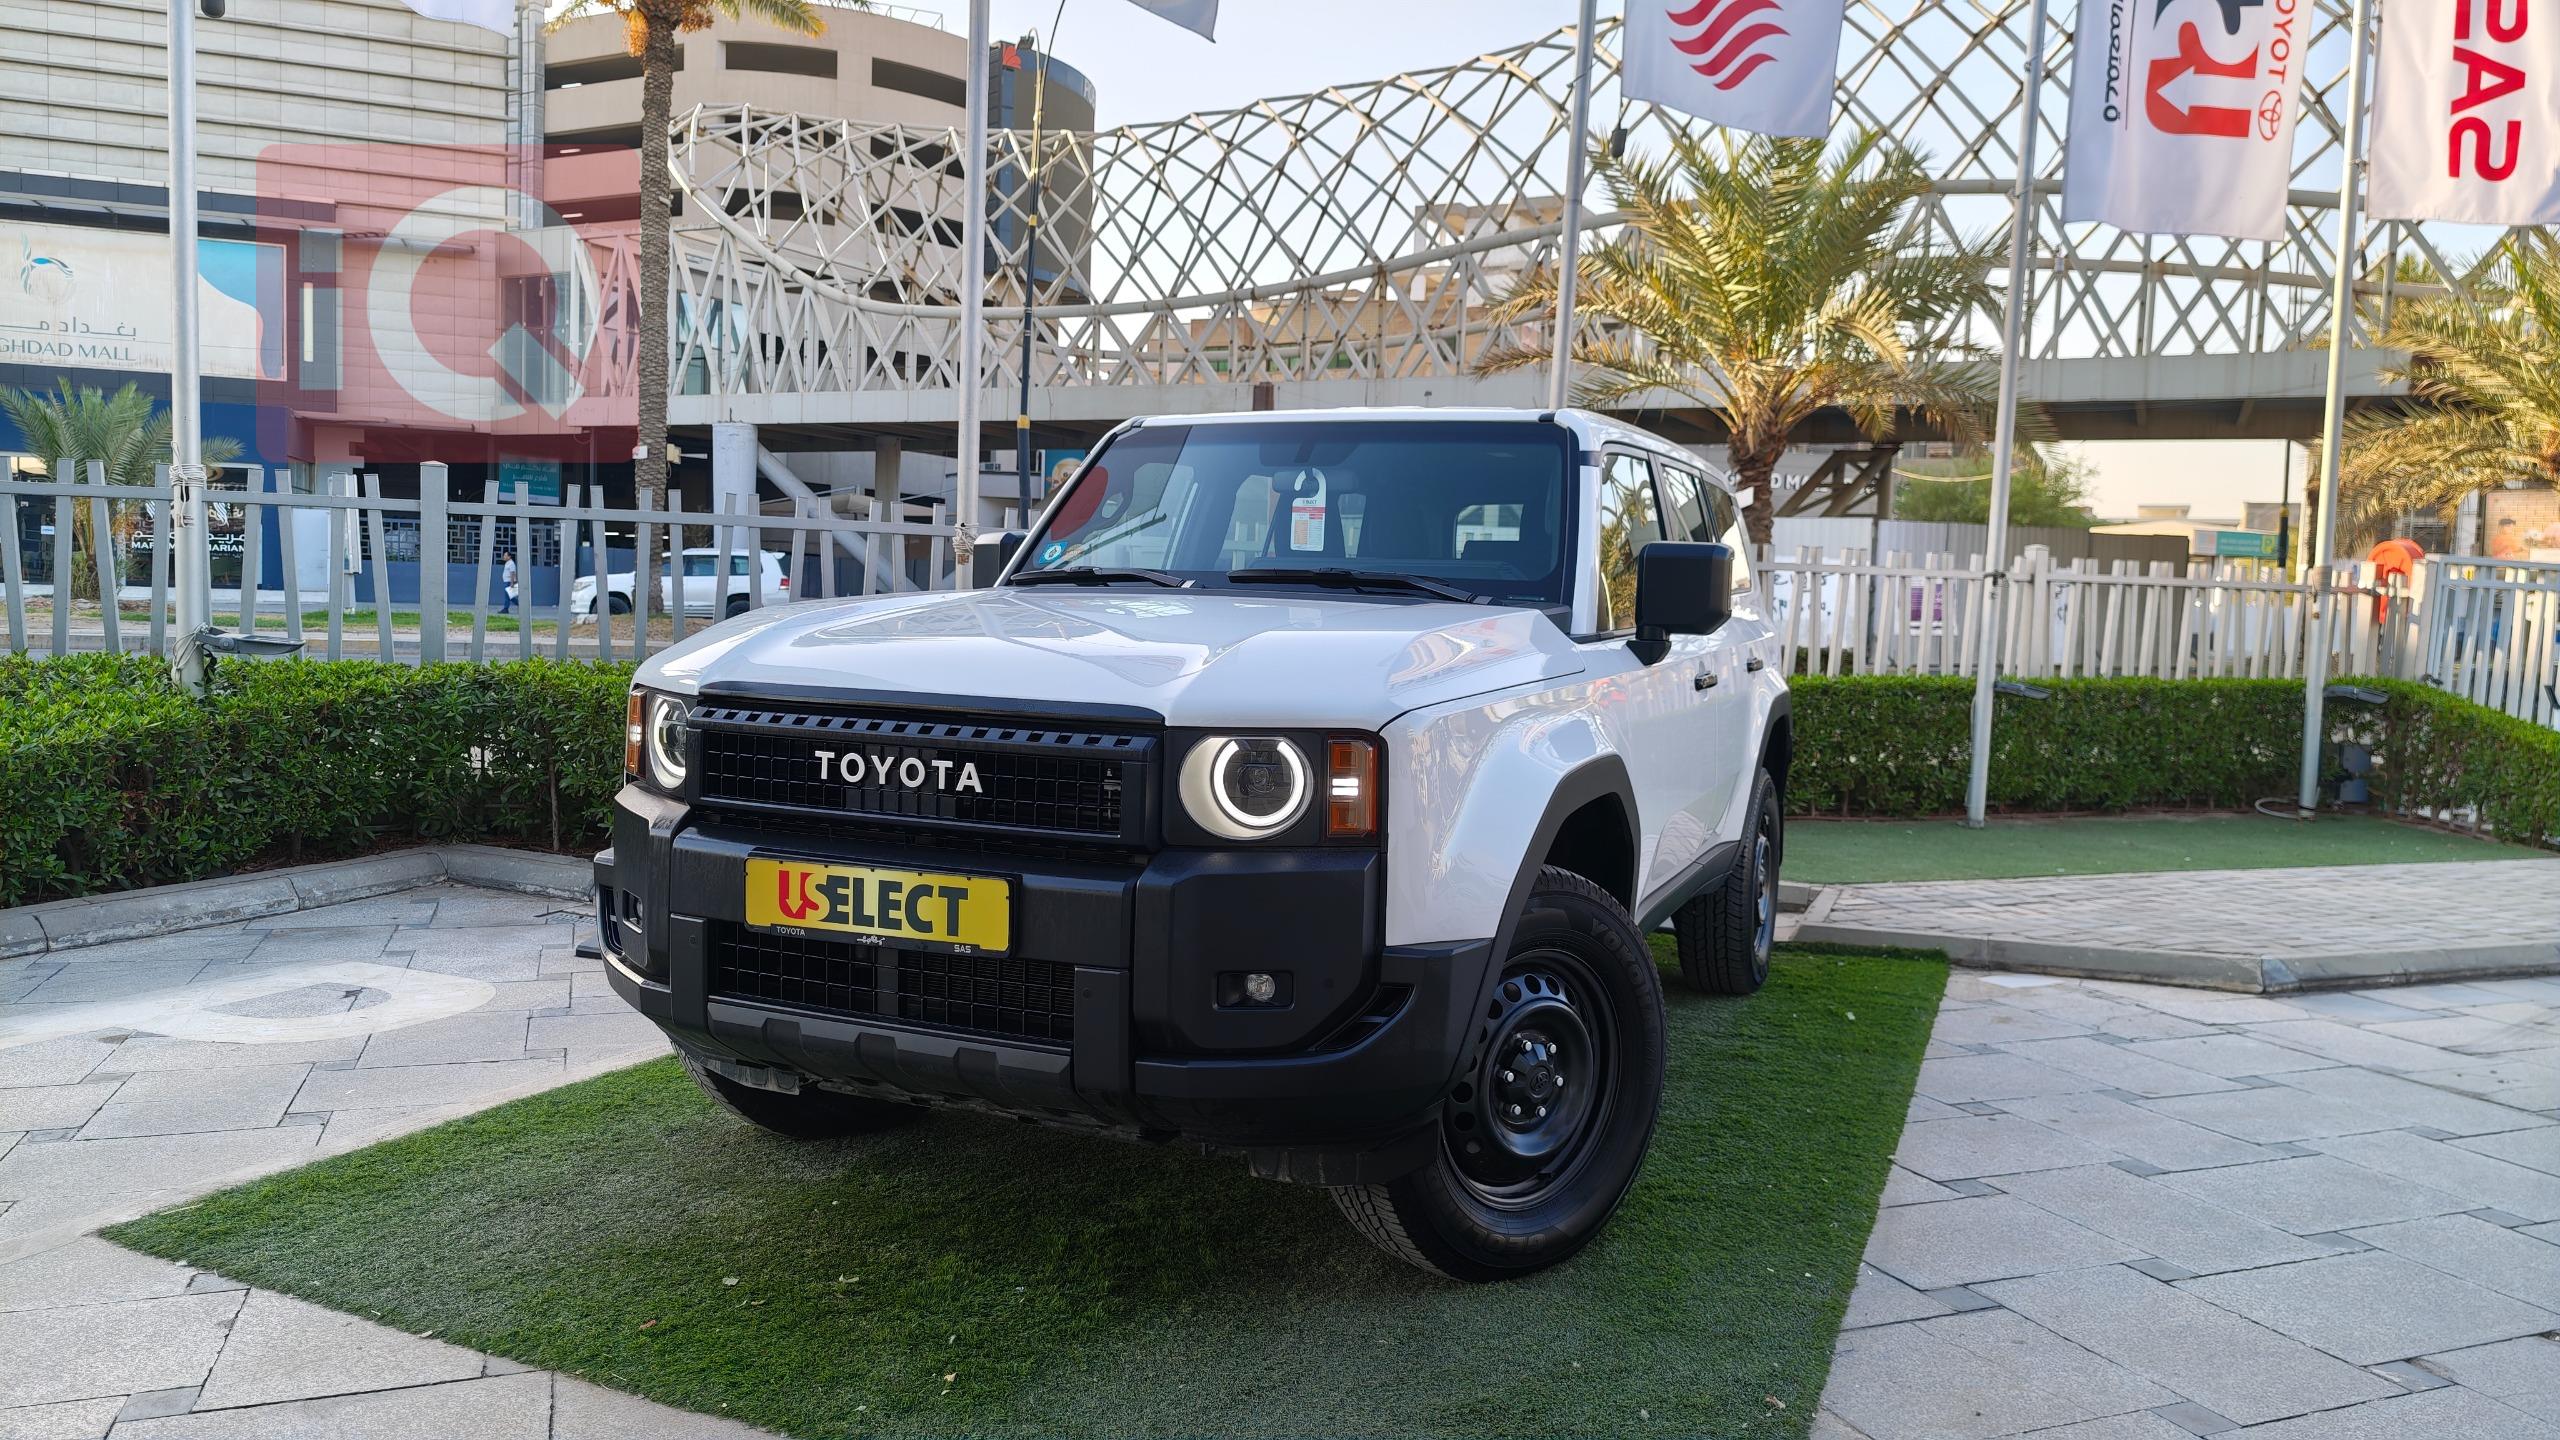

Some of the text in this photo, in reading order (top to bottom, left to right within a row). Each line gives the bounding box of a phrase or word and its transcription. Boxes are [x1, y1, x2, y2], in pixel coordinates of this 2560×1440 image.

[58, 316, 137, 341] بغداد
[78, 343, 137, 361] MALL
[814, 750, 984, 793] TOYOTA
[778, 869, 969, 937] USELECT
[776, 926, 806, 936] TOYOTA
[953, 944, 972, 954] SAS
